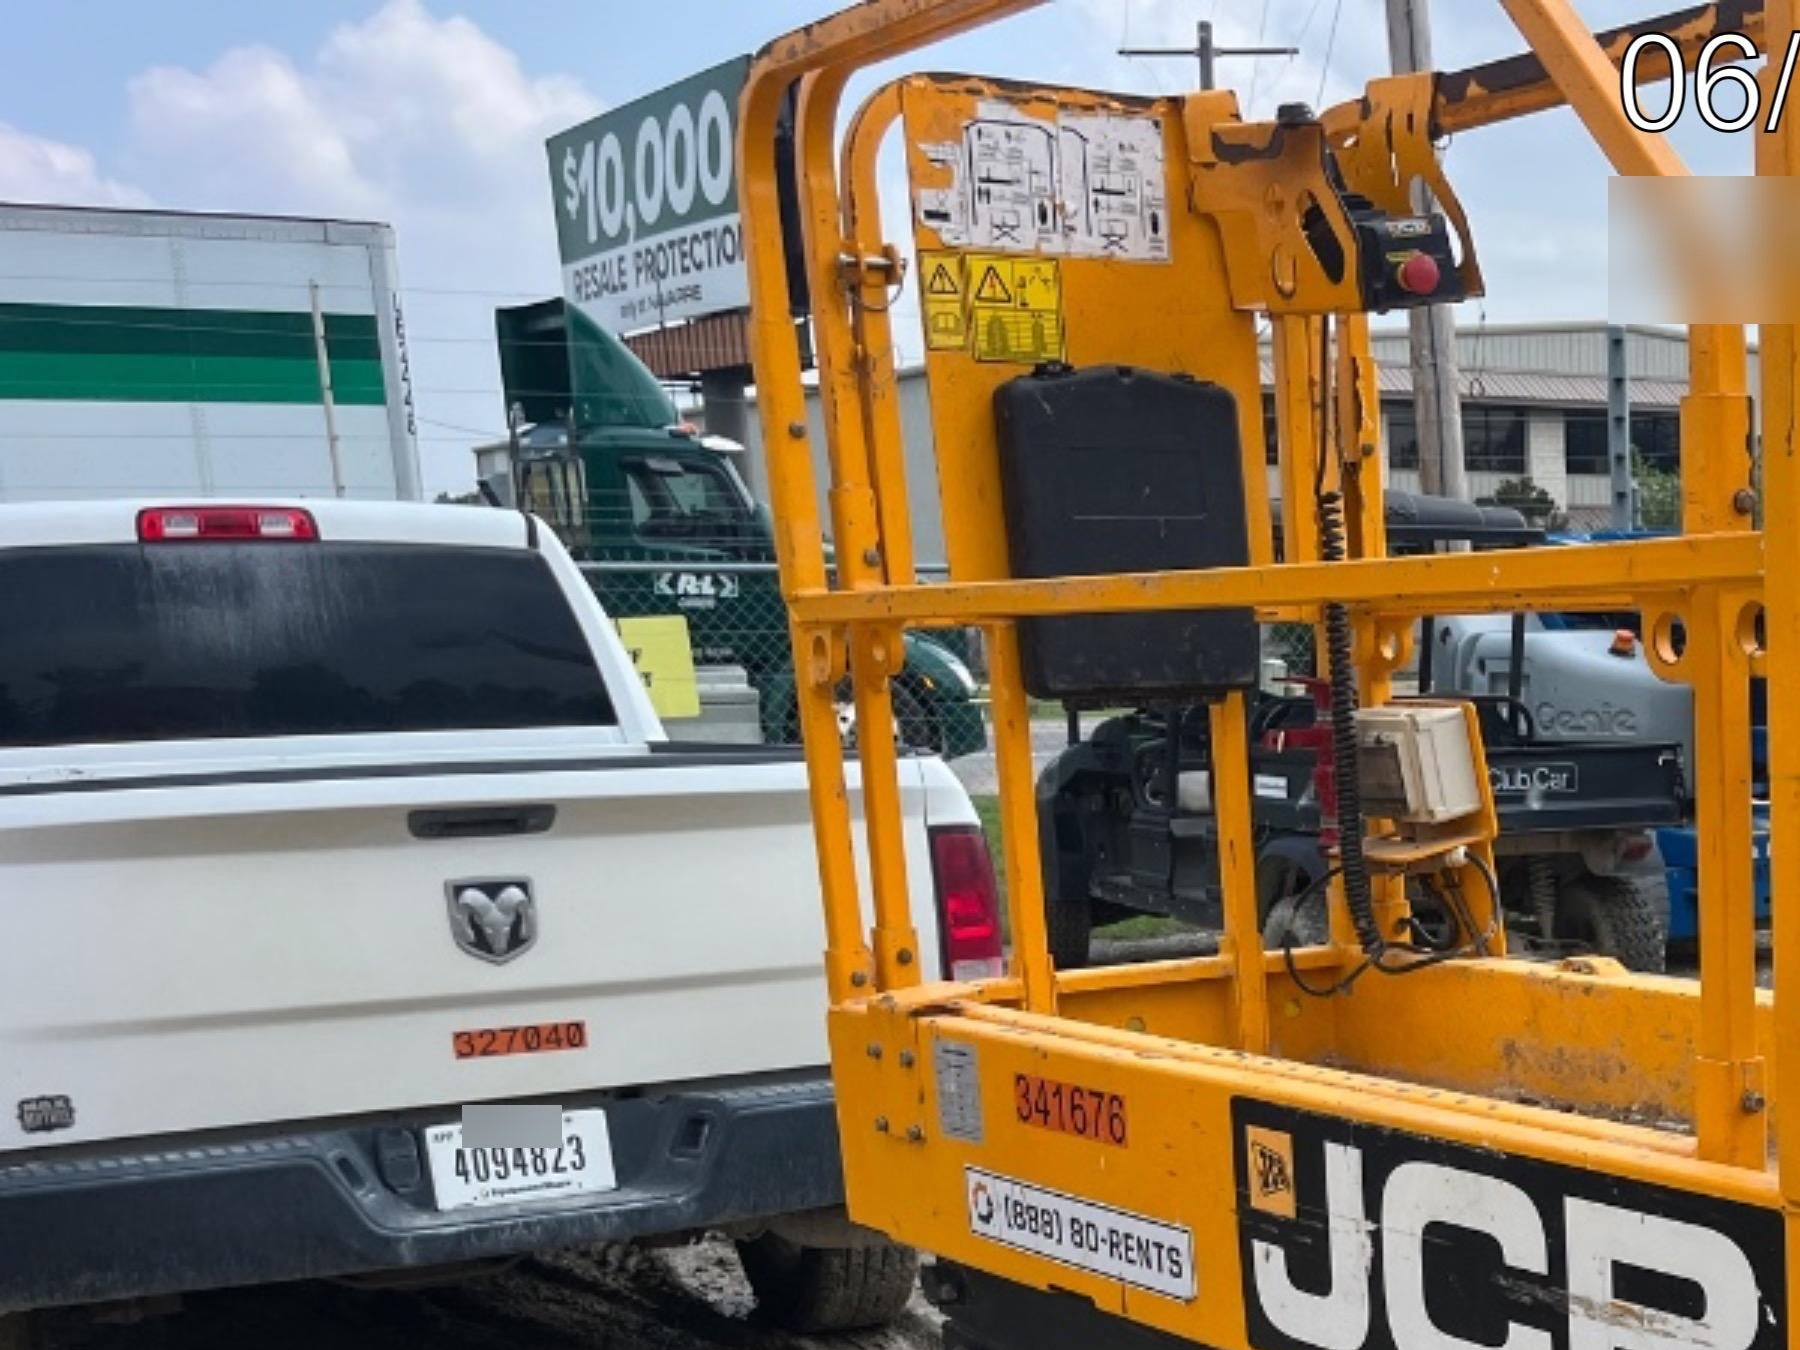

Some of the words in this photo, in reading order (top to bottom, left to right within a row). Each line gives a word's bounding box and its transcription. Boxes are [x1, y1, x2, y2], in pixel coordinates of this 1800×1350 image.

[563, 89, 732, 244] $10,000
[574, 255, 627, 302] RESALE
[1536, 701, 1638, 737] Genie
[454, 1022, 584, 1058] 327040
[1014, 1073, 1127, 1145] 341676
[1003, 1196, 1063, 1246] (888)
